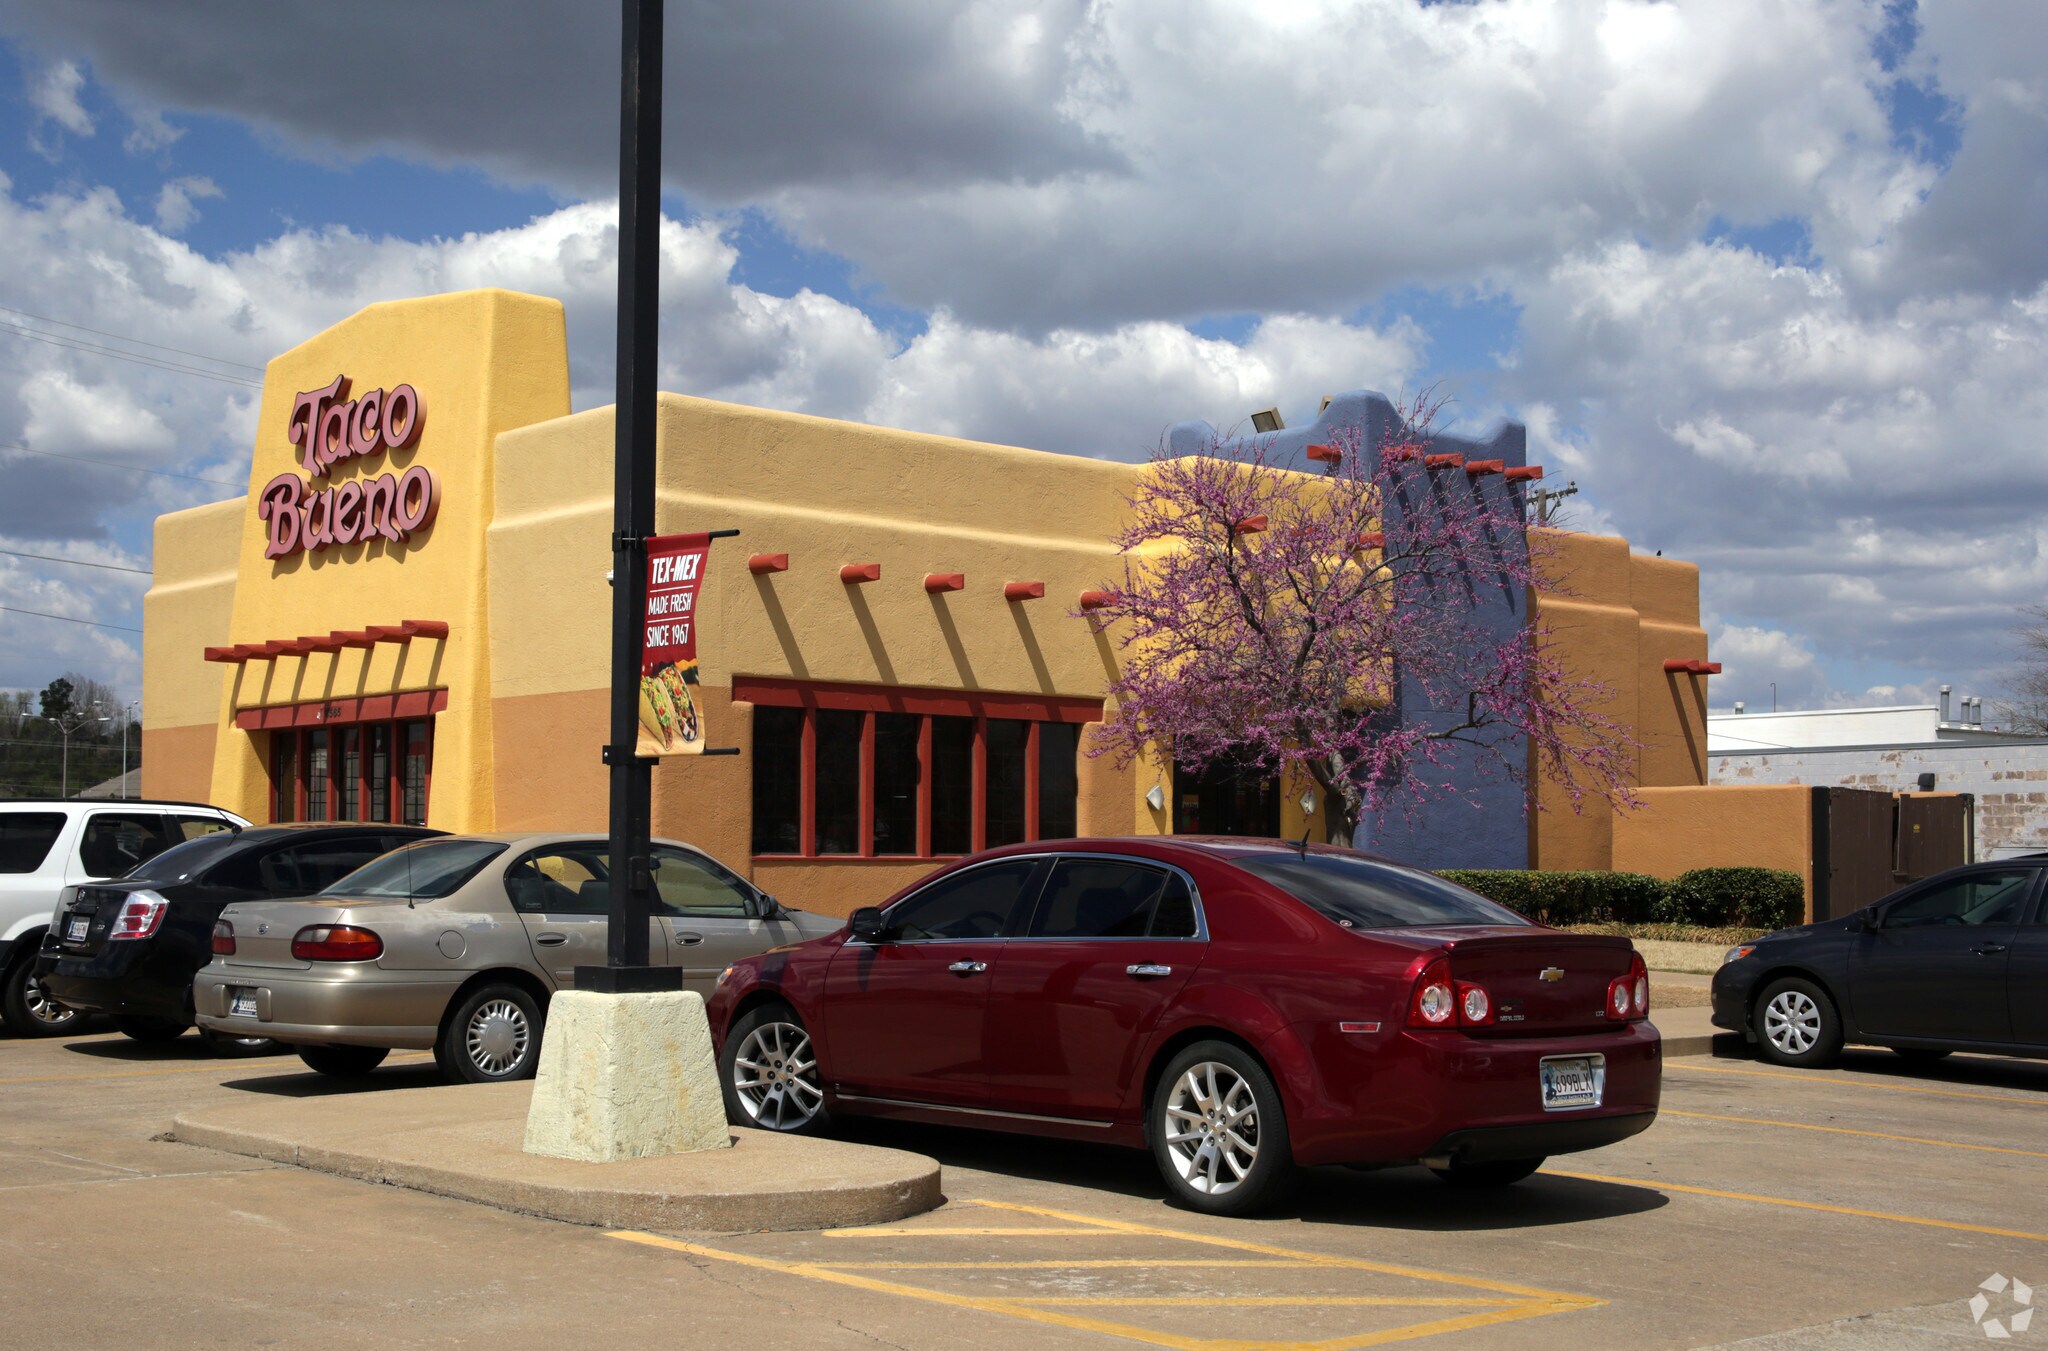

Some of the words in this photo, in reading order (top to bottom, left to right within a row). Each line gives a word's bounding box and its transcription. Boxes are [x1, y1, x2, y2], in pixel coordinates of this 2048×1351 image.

[288, 374, 427, 479] Taco
[259, 465, 441, 561] Bueno
[652, 554, 702, 585] TEX-MEX
[648, 595, 669, 616] MADE
[670, 592, 693, 612] FRESH
[646, 625, 669, 648] SINCE
[672, 623, 690, 645] 1967
